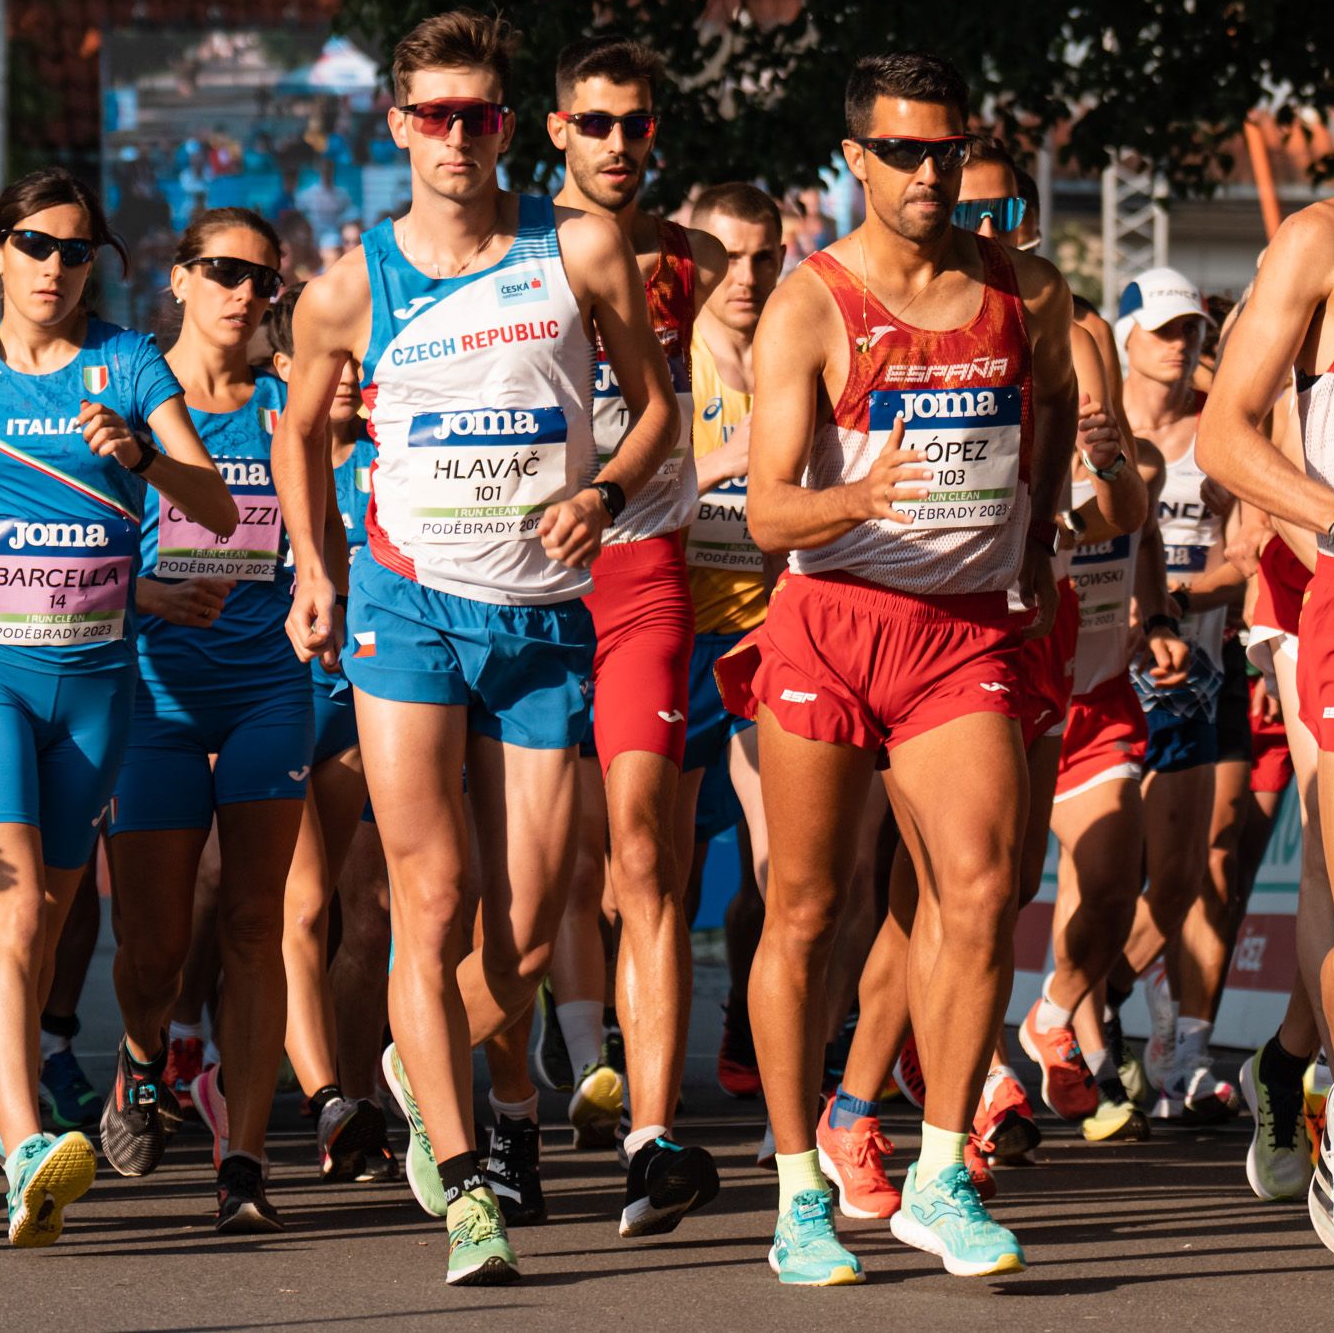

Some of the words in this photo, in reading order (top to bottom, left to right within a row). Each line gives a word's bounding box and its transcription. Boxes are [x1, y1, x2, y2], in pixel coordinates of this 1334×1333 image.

[501, 282, 530, 295] ČESKÁ
[392, 338, 456, 366] CZECH
[461, 320, 559, 352] REPUBLIC
[885, 357, 1008, 383] ESPAÑA
[6, 418, 83, 436] ITALIA
[910, 436, 989, 463] ÓPEZ
[434, 451, 540, 480] HLAVÁČ
[219, 462, 269, 486] ma
[937, 470, 965, 486] 103
[475, 486, 501, 501] 101
[948, 491, 980, 500] CLEAN
[461, 509, 483, 517] RUN
[486, 507, 519, 516] CLEAN
[896, 507, 976, 520] DĚBRADY
[979, 505, 1007, 517] 2023
[422, 521, 515, 535] PODĚBRADY
[519, 518, 540, 532] 202
[196, 550, 216, 558] RUN
[217, 550, 248, 559] CLEAN
[695, 552, 763, 566] PODĚBRAD
[159, 560, 243, 575] PODĚBRADY
[245, 563, 276, 576] 2023
[1072, 569, 1124, 587] OWSKI
[49, 594, 66, 609] 14
[30, 615, 52, 623] RUN
[54, 614, 85, 623] CLEAN
[83, 625, 111, 637] 2023
[780, 689, 817, 703] ESP
